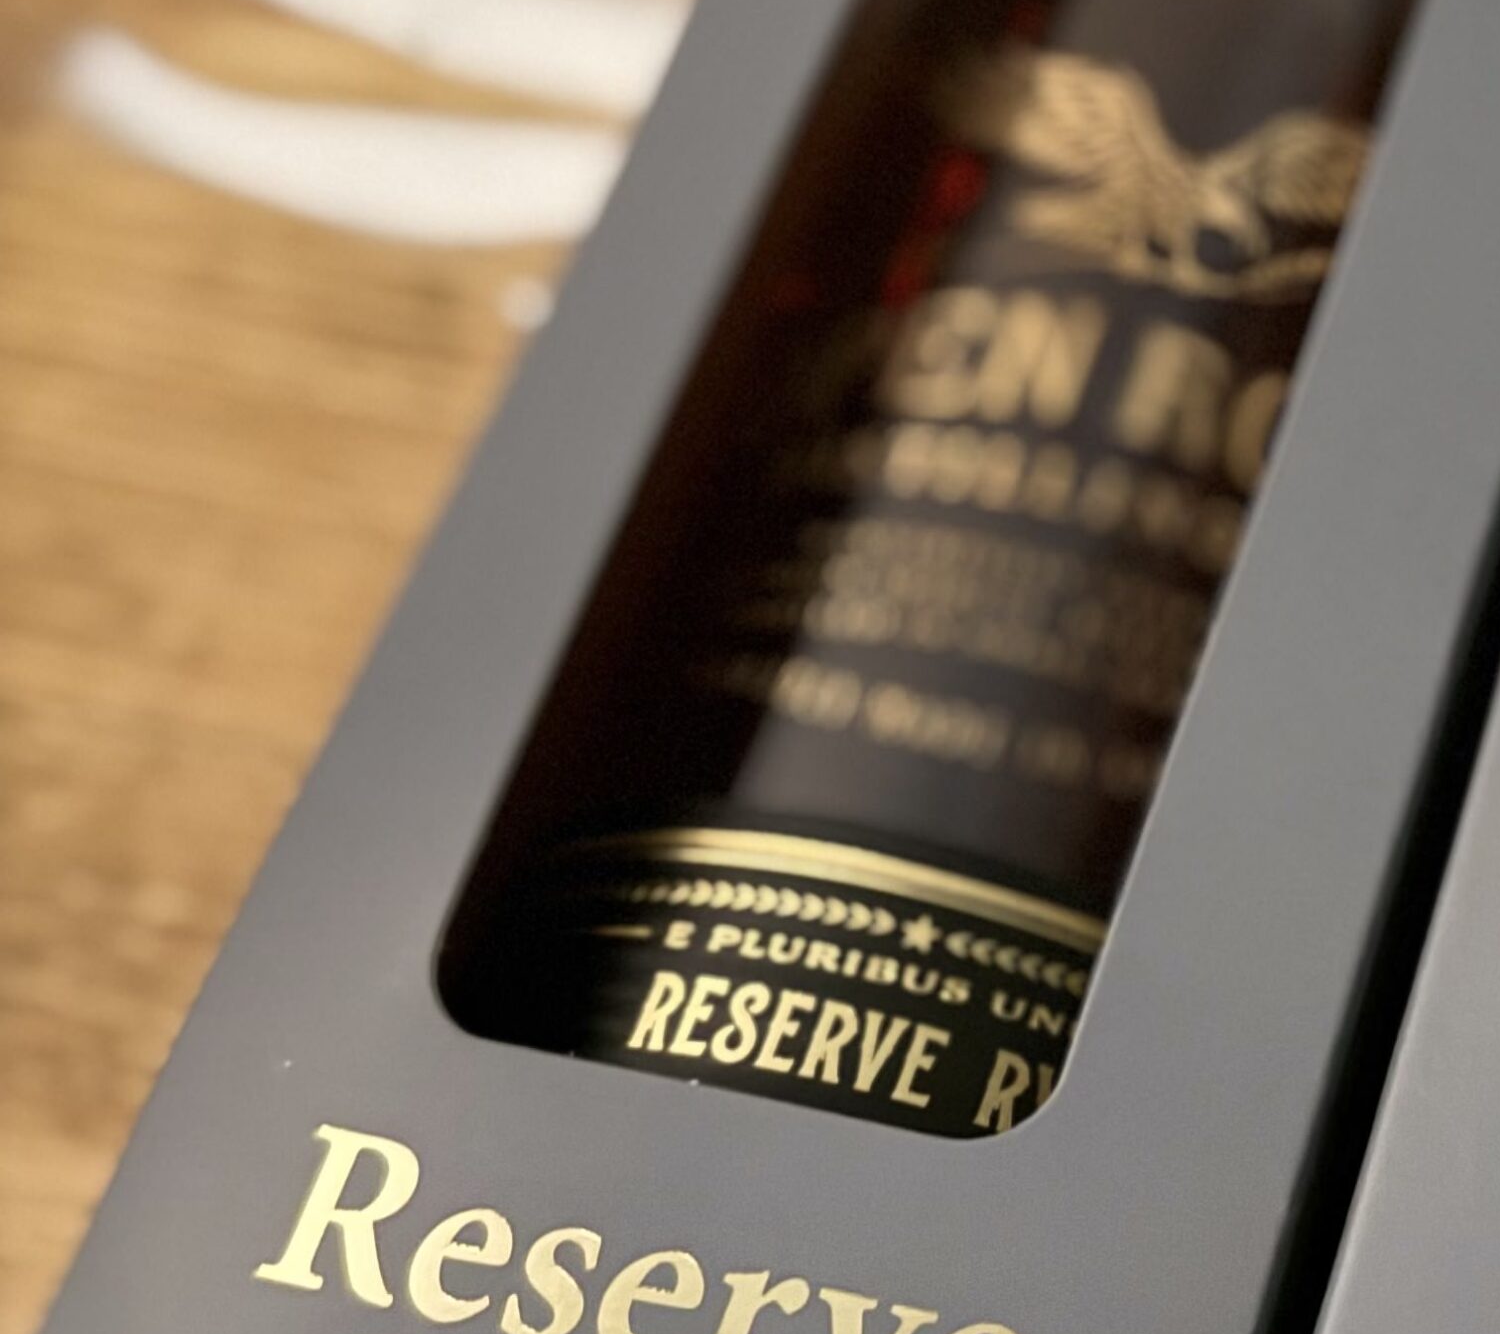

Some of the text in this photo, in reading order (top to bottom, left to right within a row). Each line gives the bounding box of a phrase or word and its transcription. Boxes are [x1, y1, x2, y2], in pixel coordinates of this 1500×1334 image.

[627, 969, 951, 1109] RESERVE
[662, 919, 1079, 1038] E PLURIBUS UN
